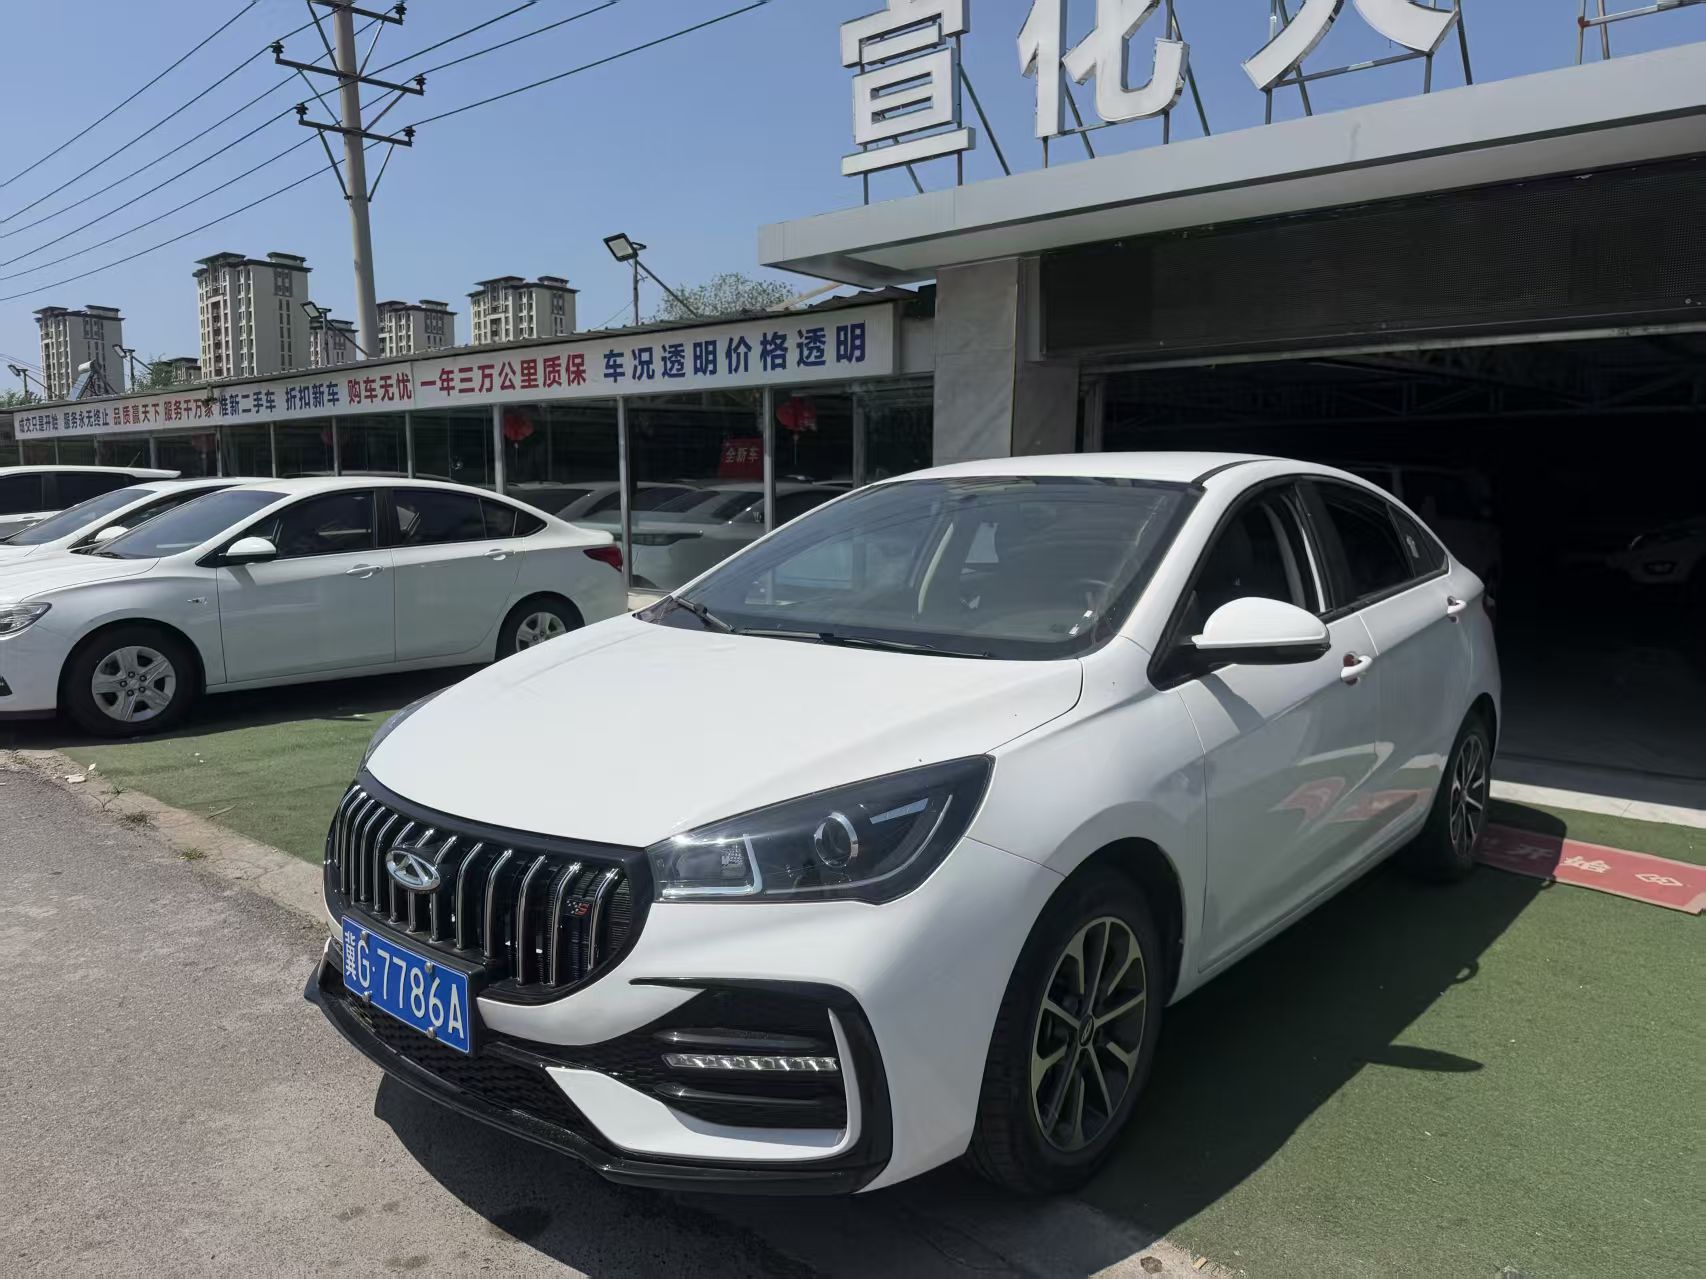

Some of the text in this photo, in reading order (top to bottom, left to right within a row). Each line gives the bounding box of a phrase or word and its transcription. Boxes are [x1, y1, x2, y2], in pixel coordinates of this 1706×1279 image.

[63, 408, 110, 430] 服务永无终止
[113, 403, 160, 426] 品质赢天下
[218, 389, 277, 417] 准新二手车
[285, 381, 340, 411] 折扣新车
[347, 372, 412, 405] 购车无忧
[419, 353, 587, 397] 一年三万公里质保
[603, 321, 867, 384] 车况透明价格透明
